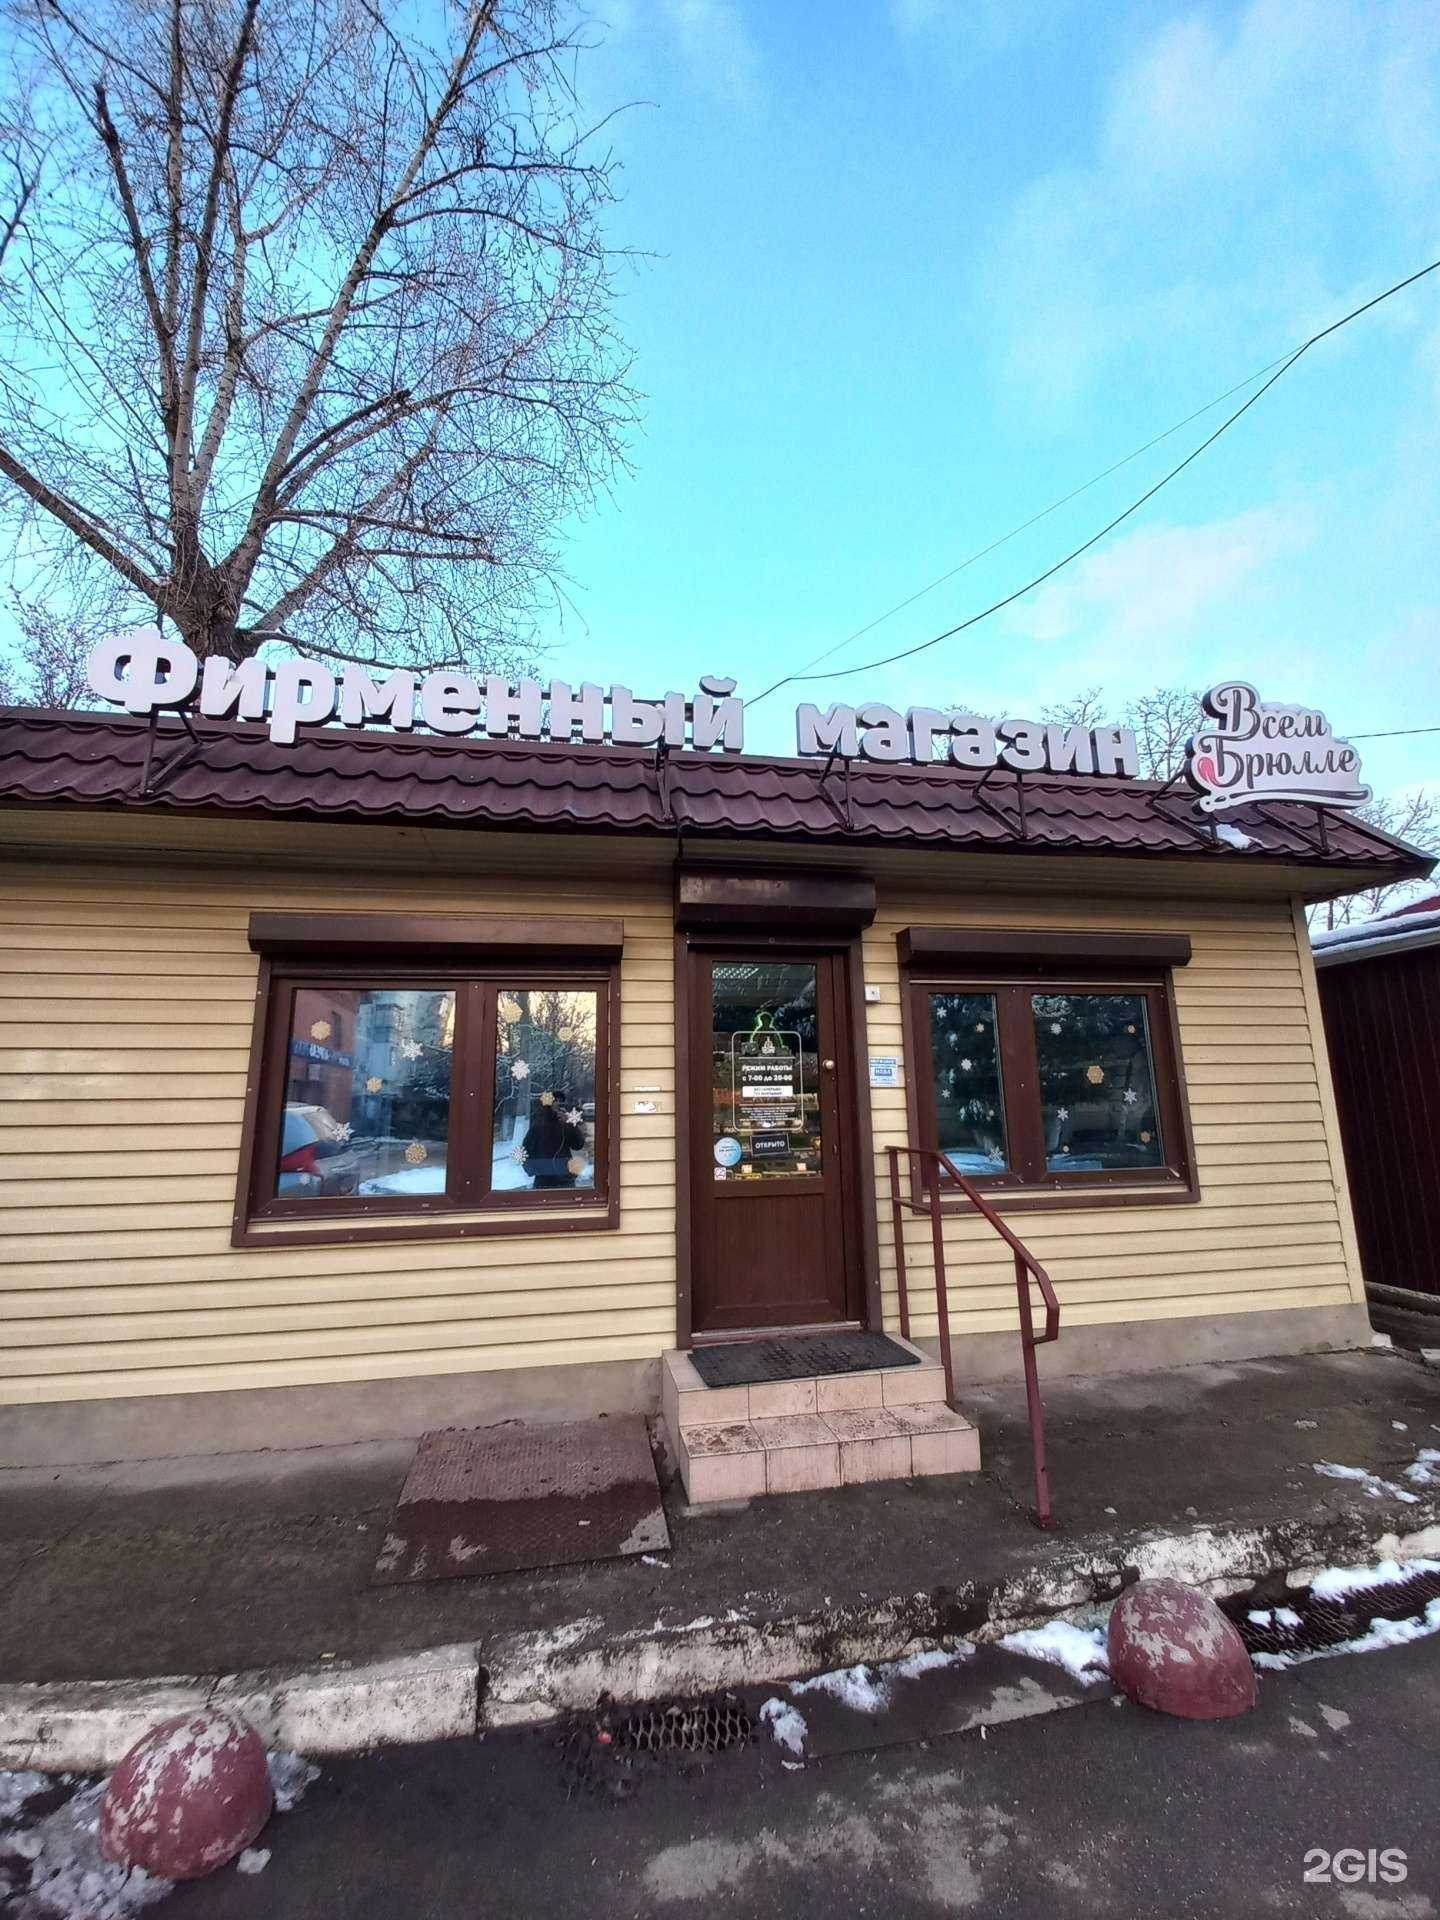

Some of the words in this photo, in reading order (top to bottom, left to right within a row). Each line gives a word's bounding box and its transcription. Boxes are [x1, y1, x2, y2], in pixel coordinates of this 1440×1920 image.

[88, 629, 743, 752] Фирменный
[796, 702, 1140, 779] магазин
[1216, 685, 1328, 742] Всем
[1197, 735, 1358, 790] Брюлле
[755, 1140, 786, 1149] ОТКРЫТО
